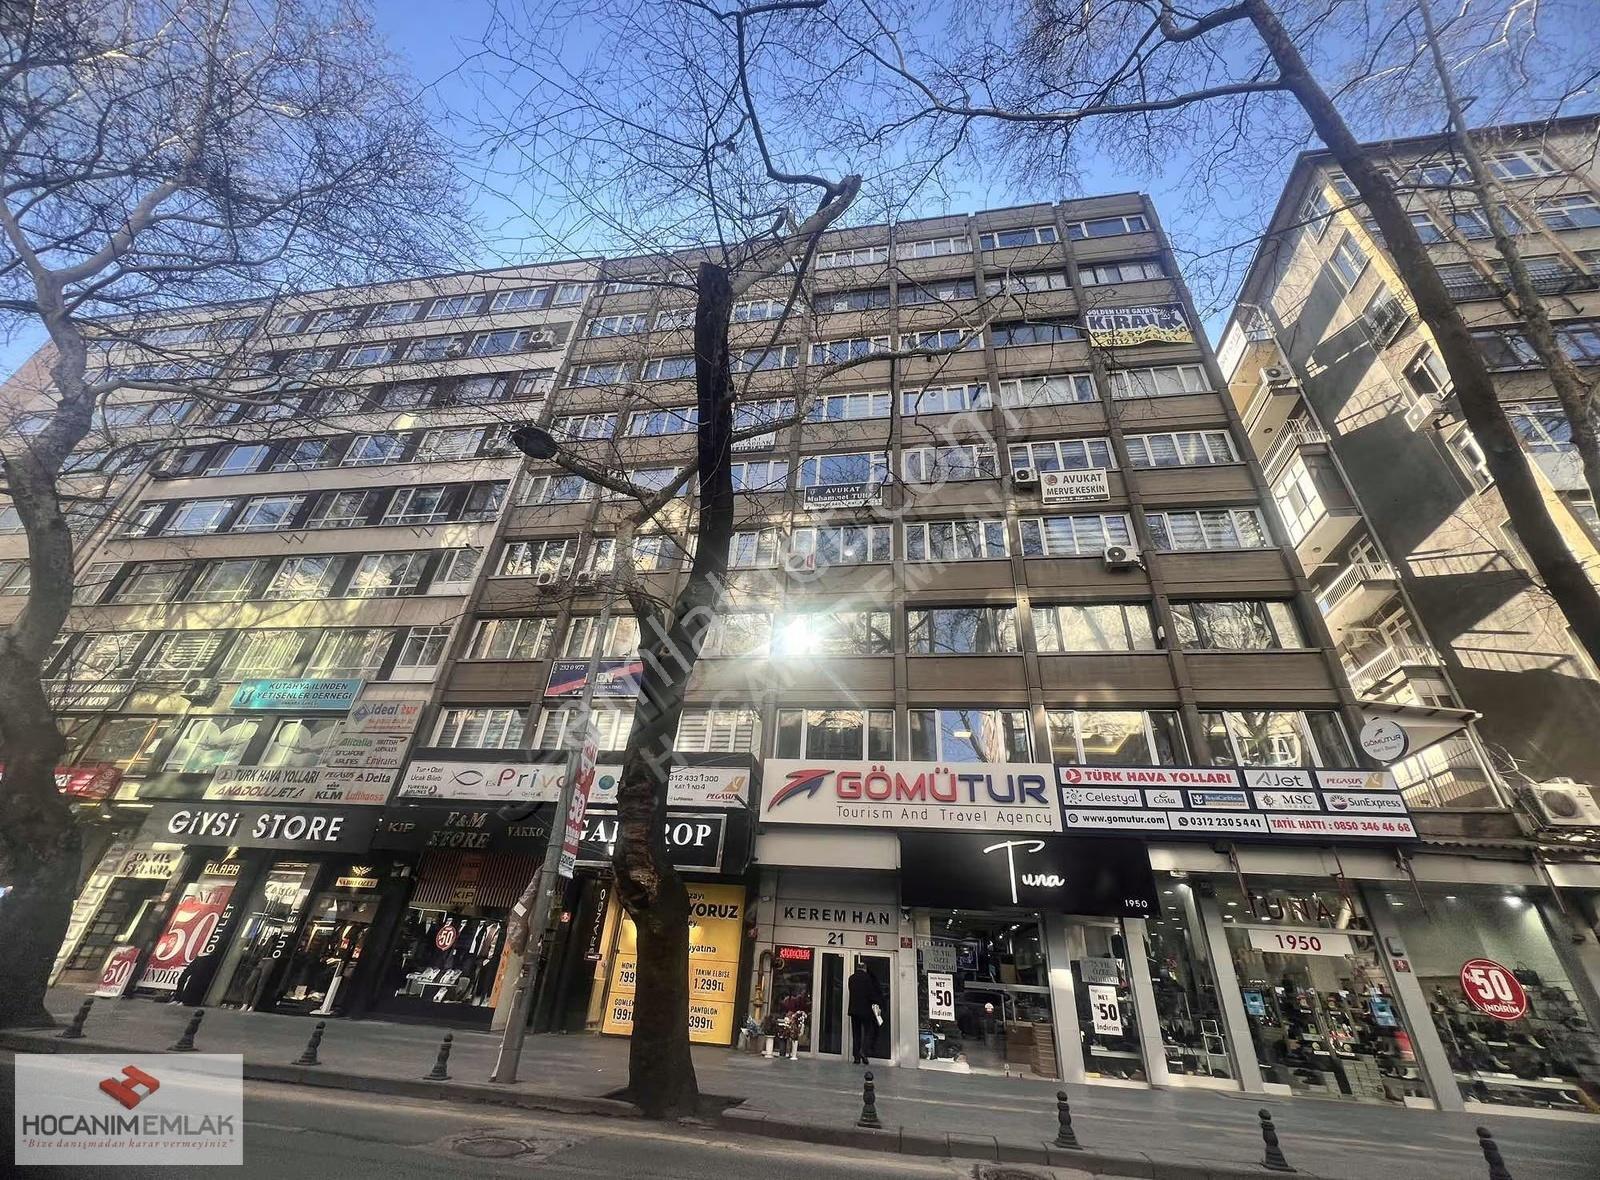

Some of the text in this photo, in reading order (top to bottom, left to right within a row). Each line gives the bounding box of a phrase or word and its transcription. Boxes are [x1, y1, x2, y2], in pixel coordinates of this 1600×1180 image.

[1063, 474, 1102, 483] AVUKAT
[825, 486, 860, 494] AVUKAT
[1046, 484, 1106, 496] MERVE KESKİN
[370, 704, 399, 715] ideal
[366, 756, 398, 766] Emirates
[258, 770, 282, 782] HAVA
[282, 770, 320, 784] YOLLARI
[364, 772, 392, 784] Delta
[684, 774, 698, 782] 433
[1085, 769, 1233, 784] TÜRK HAVA YOLLARI
[836, 765, 1049, 804] GÖMÜTUR
[314, 791, 344, 800] KLM
[1085, 792, 1139, 805] Celestyal
[1153, 796, 1176, 804] Costa
[1282, 794, 1313, 804] MSC
[1348, 798, 1401, 809] SunExpress
[836, 806, 1052, 826] Tourism And Travel Agency
[1082, 814, 1165, 824] www.gomutur.com
[1190, 816, 1214, 826] 0312
[1216, 817, 1234, 827] 230
[252, 814, 344, 842] STORE
[1270, 817, 1297, 830] TATİL
[1298, 820, 1326, 830] HATTI
[1334, 822, 1359, 831] 0850
[1361, 822, 1380, 832] 346
[1382, 822, 1395, 832] 46
[1397, 822, 1411, 832] 68
[506, 826, 544, 838] VAKKO
[426, 831, 491, 848] STORE
[983, 840, 1066, 904] Tuna
[453, 890, 474, 898] KIP
[1124, 899, 1148, 908] 1950
[688, 903, 739, 920] YORUZ
[784, 906, 890, 925] KEREM HAN
[205, 903, 234, 954] OUTLET
[155, 911, 220, 964] 50
[438, 930, 454, 947] 50
[828, 932, 844, 945] 21
[1275, 934, 1322, 952] 1950
[103, 960, 130, 985] 50
[694, 978, 726, 992] 1.299TL
[688, 1015, 714, 1030] 399TL
